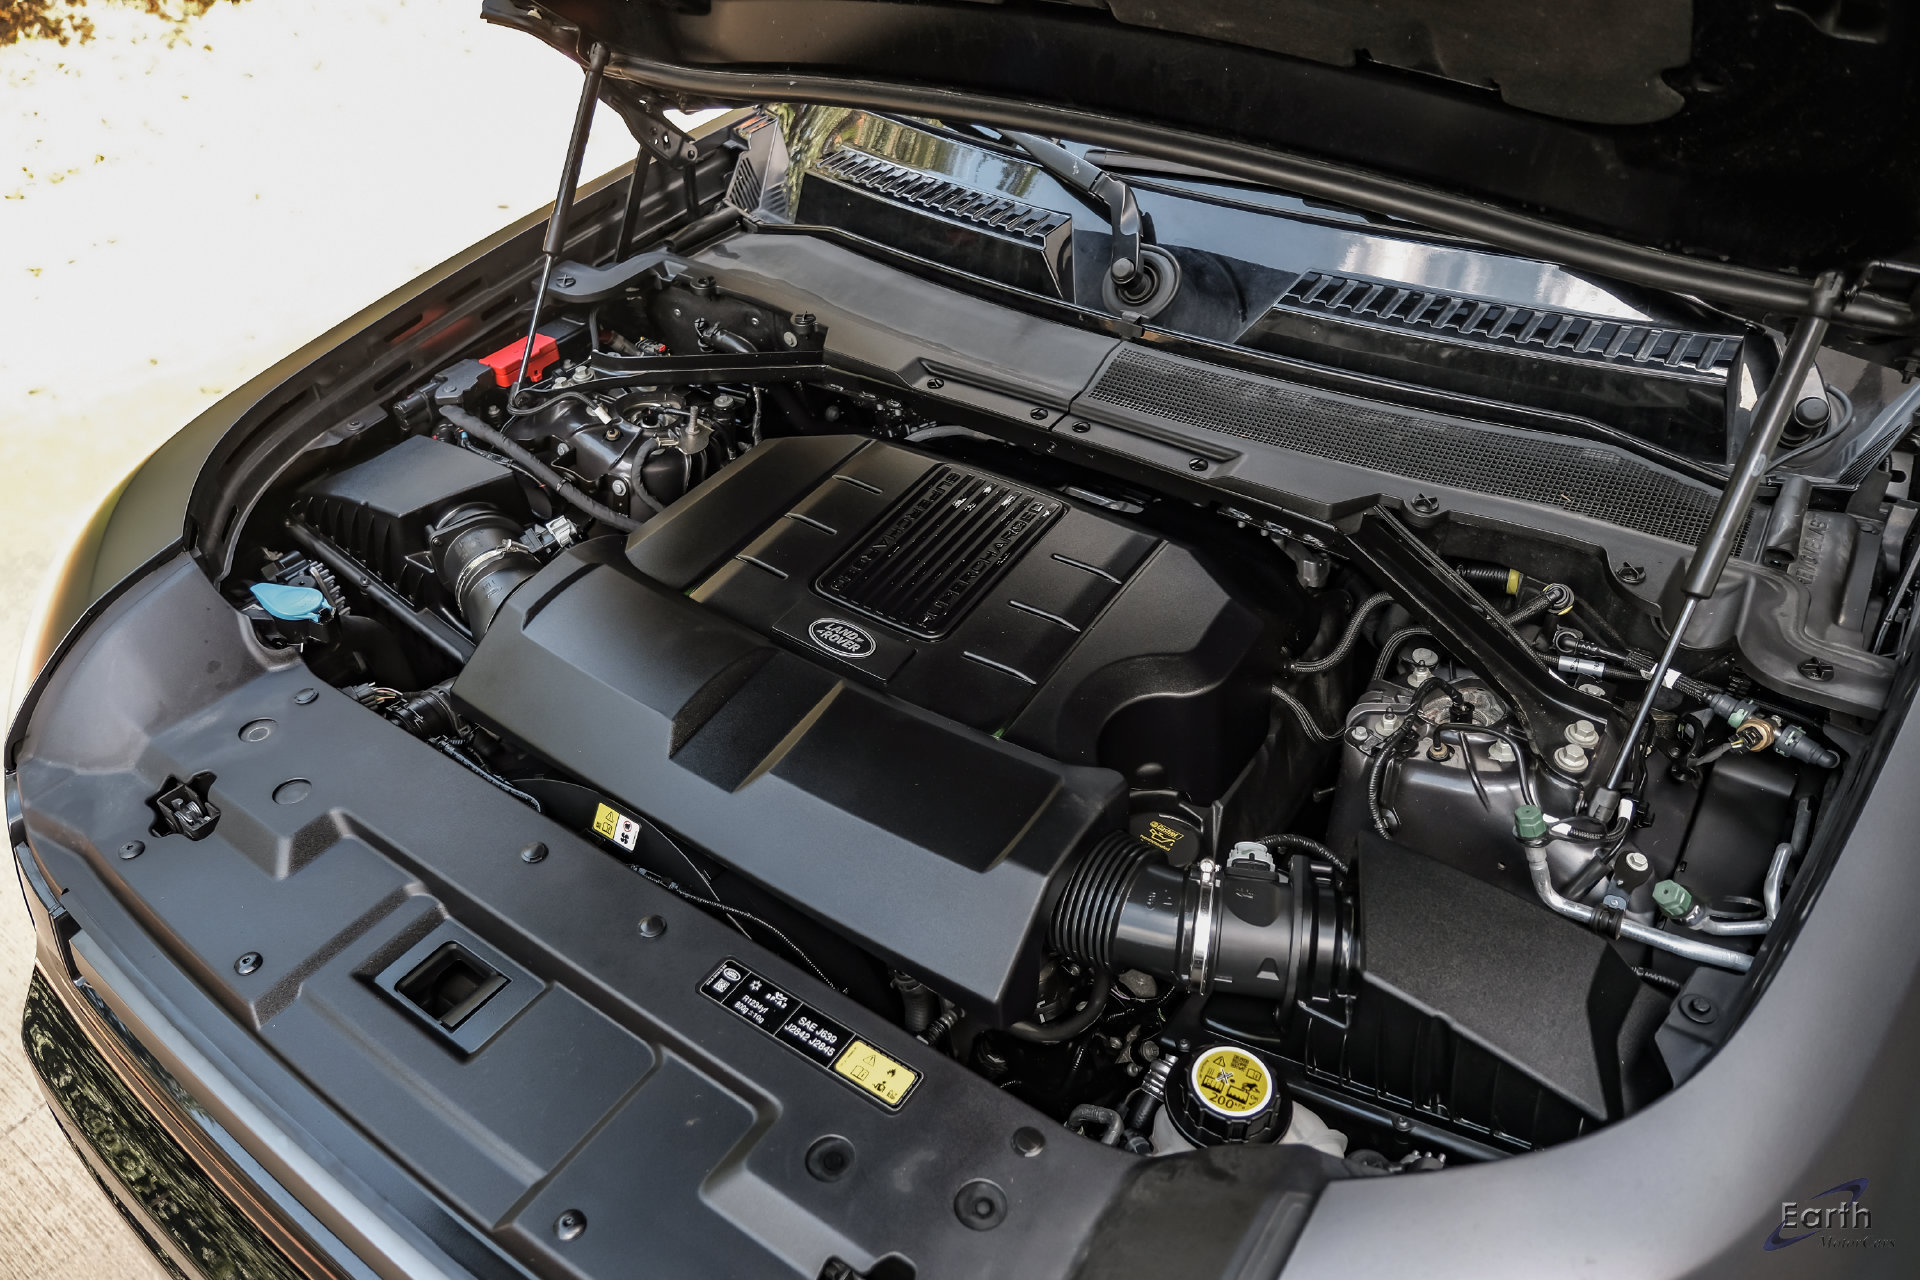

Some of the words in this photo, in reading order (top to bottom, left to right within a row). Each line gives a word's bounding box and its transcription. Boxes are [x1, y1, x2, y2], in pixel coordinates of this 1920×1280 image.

[820, 630, 861, 652] ROVER
[824, 623, 859, 641] LAND
[742, 994, 769, 1014] R1234yf
[784, 1022, 810, 1042] J2842
[808, 1037, 836, 1056] J2845
[798, 1016, 817, 1033] SAE
[815, 1027, 838, 1043] J639
[1209, 1091, 1234, 1109] 200
